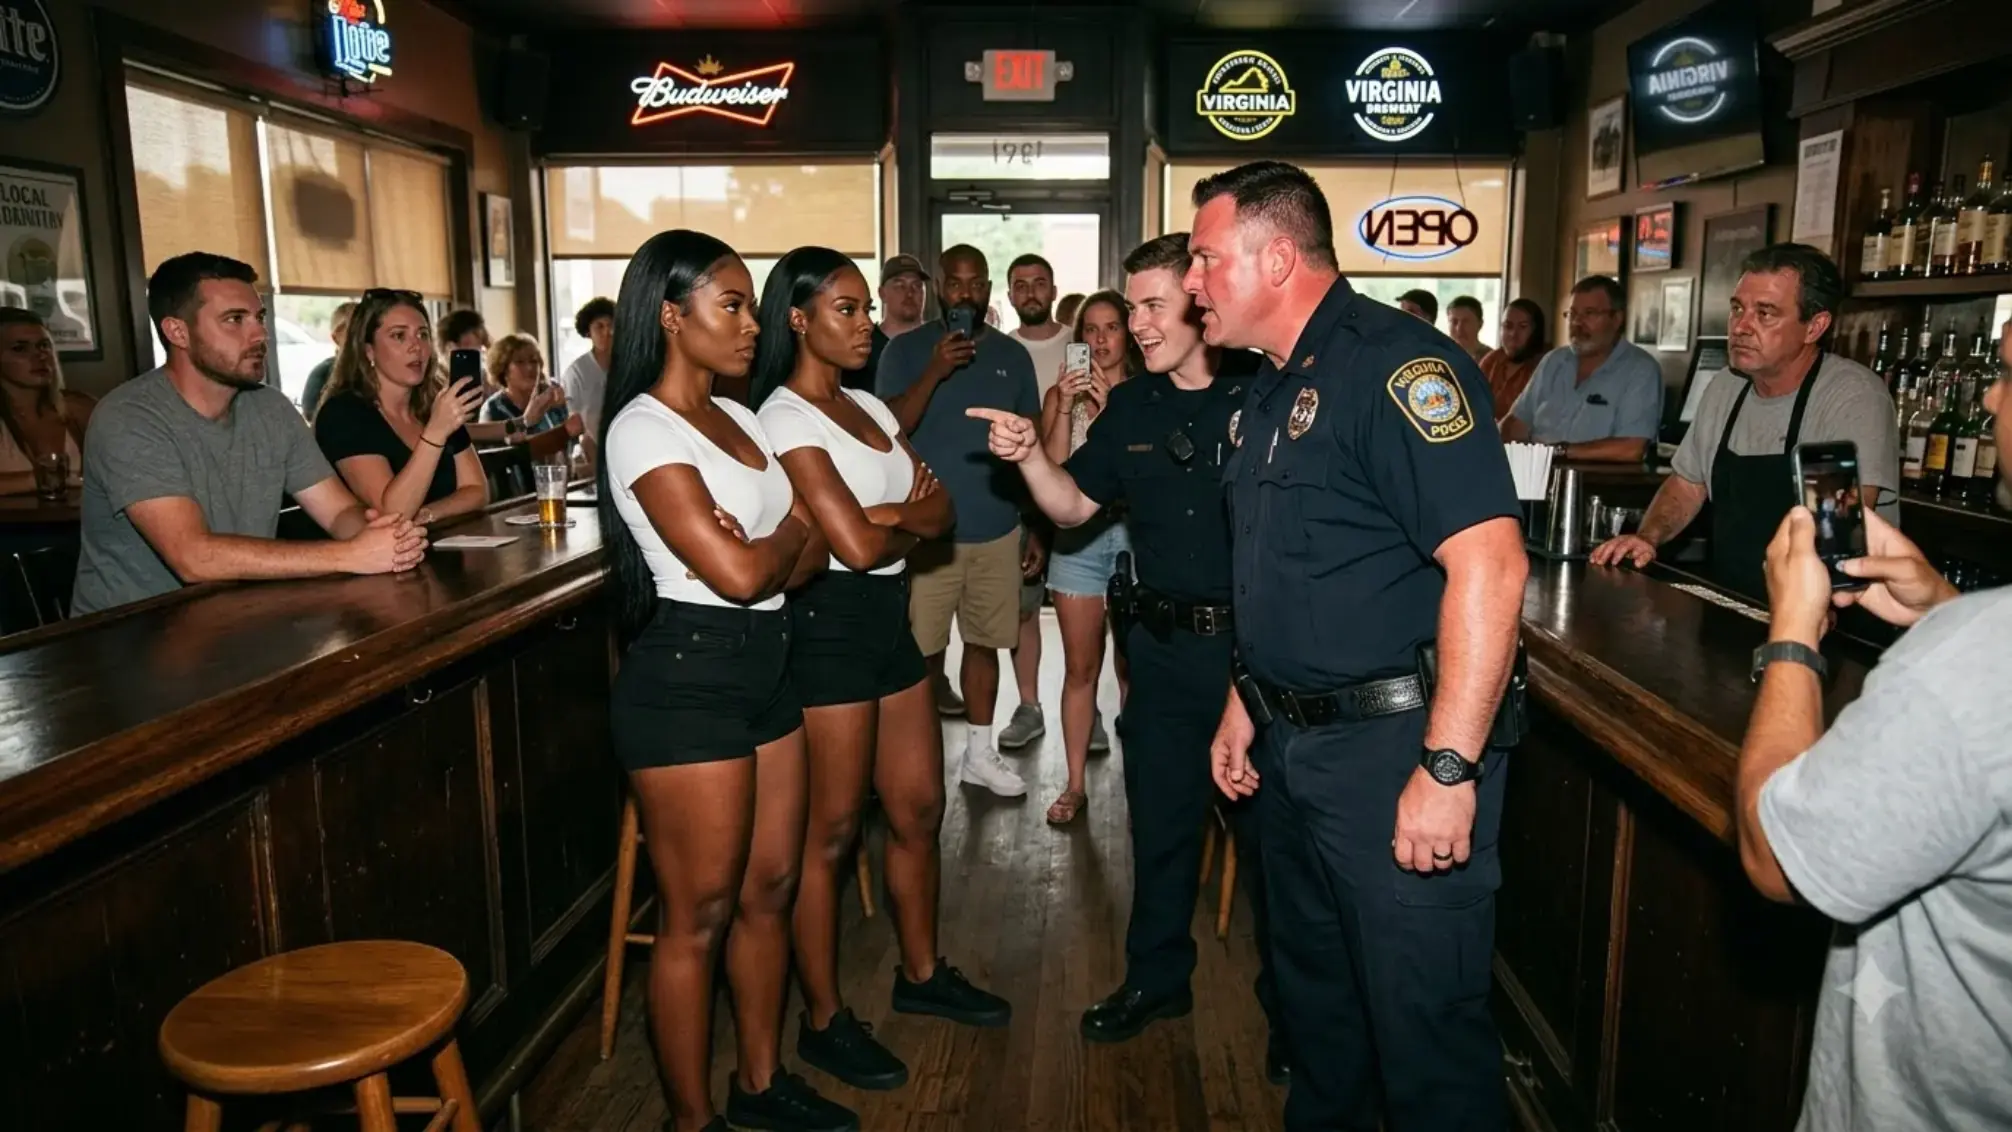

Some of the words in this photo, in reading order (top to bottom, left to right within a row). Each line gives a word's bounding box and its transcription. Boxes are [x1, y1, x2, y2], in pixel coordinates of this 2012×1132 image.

[995, 51, 1047, 89] EXIT
[631, 77, 788, 107] Budweiser
[1202, 94, 1290, 110] VIRGINIA
[1345, 80, 1442, 103] VIRGINIA
